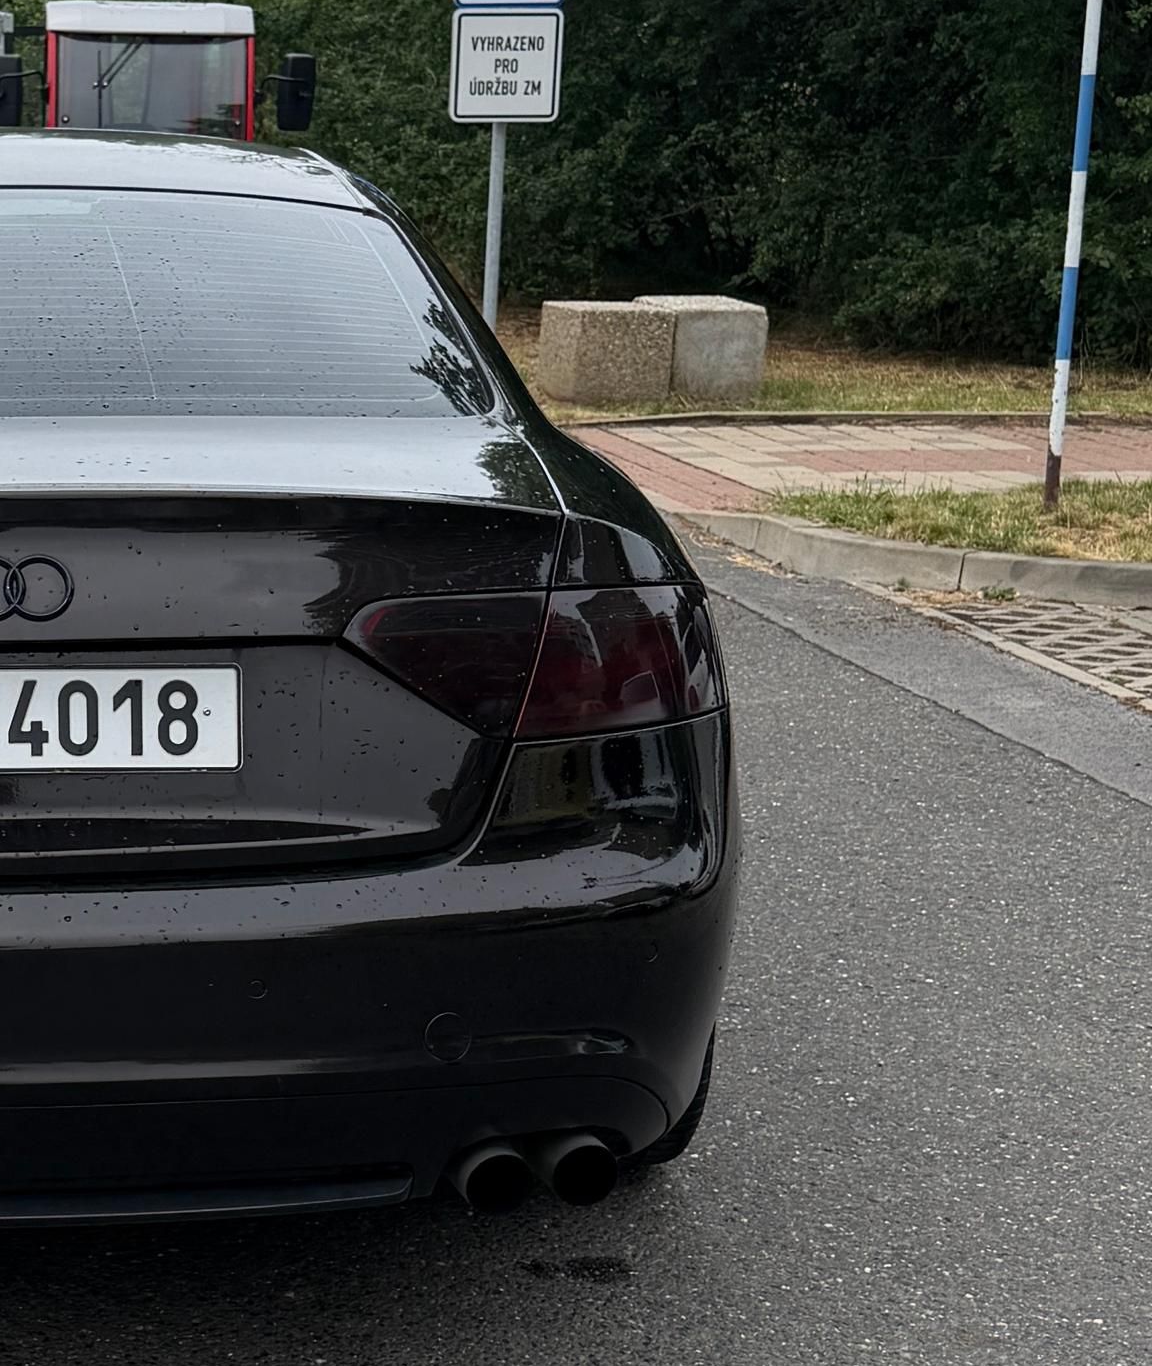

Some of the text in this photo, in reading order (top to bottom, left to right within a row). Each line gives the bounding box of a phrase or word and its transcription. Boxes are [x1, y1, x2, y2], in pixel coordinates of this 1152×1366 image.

[471, 35, 545, 52] VYHRAZENO
[493, 58, 519, 74] PRO
[469, 77, 542, 96] ÚDRŽBU ZM
[8, 679, 199, 757] 4018
